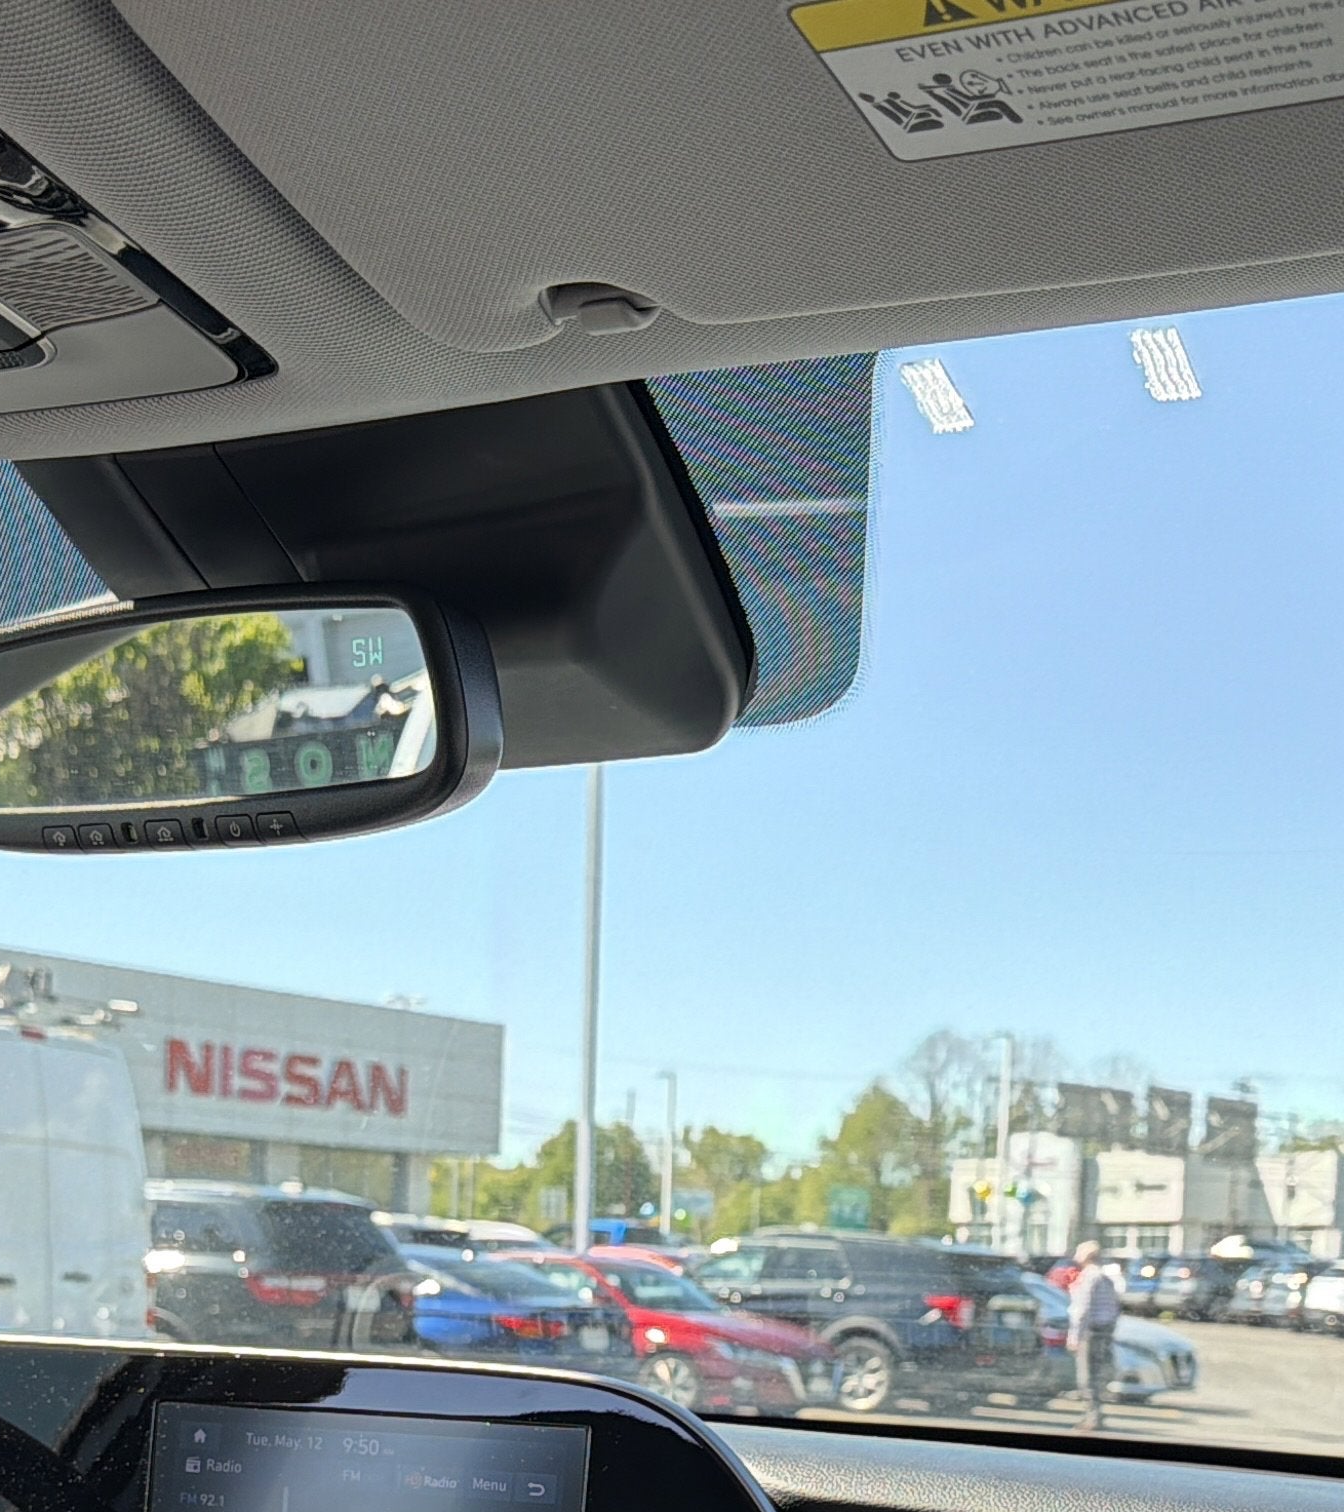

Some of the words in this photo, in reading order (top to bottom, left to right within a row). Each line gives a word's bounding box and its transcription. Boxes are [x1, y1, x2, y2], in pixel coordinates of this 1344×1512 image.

[895, 39, 964, 63] EVEN
[966, 27, 1036, 50] WITH
[1043, 0, 1188, 39] ADVANCED
[1007, 46, 1063, 63] Children
[1065, 42, 1093, 54] can
[1093, 38, 1114, 49] be
[1115, 31, 1153, 46] killed
[1155, 29, 1169, 38] or
[1172, 18, 1232, 36] seriously
[1234, 9, 1285, 25] injured
[1286, 5, 1306, 17] by
[1016, 69, 1044, 79] The
[1044, 62, 1081, 75] back
[1083, 55, 1113, 68] seat
[1114, 53, 1128, 64] is
[1128, 49, 1153, 61] the
[1154, 41, 1197, 57] safest
[1198, 34, 1242, 51] place
[1242, 31, 1263, 42] for
[1265, 21, 1325, 40] children
[1026, 81, 1068, 95] Never
[1069, 76, 1095, 91] put
[1095, 74, 1108, 85] a
[1108, 62, 1185, 82] rear-facing
[1186, 56, 1222, 70] child
[1223, 50, 1254, 64] seat
[1256, 48, 1272, 58] in
[1272, 43, 1298, 55] the
[1299, 36, 1334, 50] front
[1039, 95, 1086, 112] Always
[1086, 92, 1111, 103] use
[1112, 86, 1143, 99] seat
[1143, 79, 1180, 94] belts
[1180, 76, 1210, 89] and
[1211, 69, 1247, 84] child
[1248, 58, 1313, 78] restraints
[1047, 115, 1074, 126] See
[1075, 106, 1126, 122] owner's
[1127, 98, 1179, 113] manual
[1180, 95, 1200, 106] for
[1201, 89, 1238, 102] more
[1239, 75, 1320, 97] information
[352, 637, 383, 667] SW
[165, 1037, 410, 1119] NISSAN
[307, 1436, 323, 1450] 12
[342, 1437, 380, 1456] 9:50
[206, 1459, 243, 1474] Radio
[343, 1470, 361, 1482] FM
[423, 1475, 457, 1490] Radio
[472, 1477, 506, 1492] Menu
[179, 1492, 197, 1505] FM
[199, 1494, 225, 1507] 92.1
